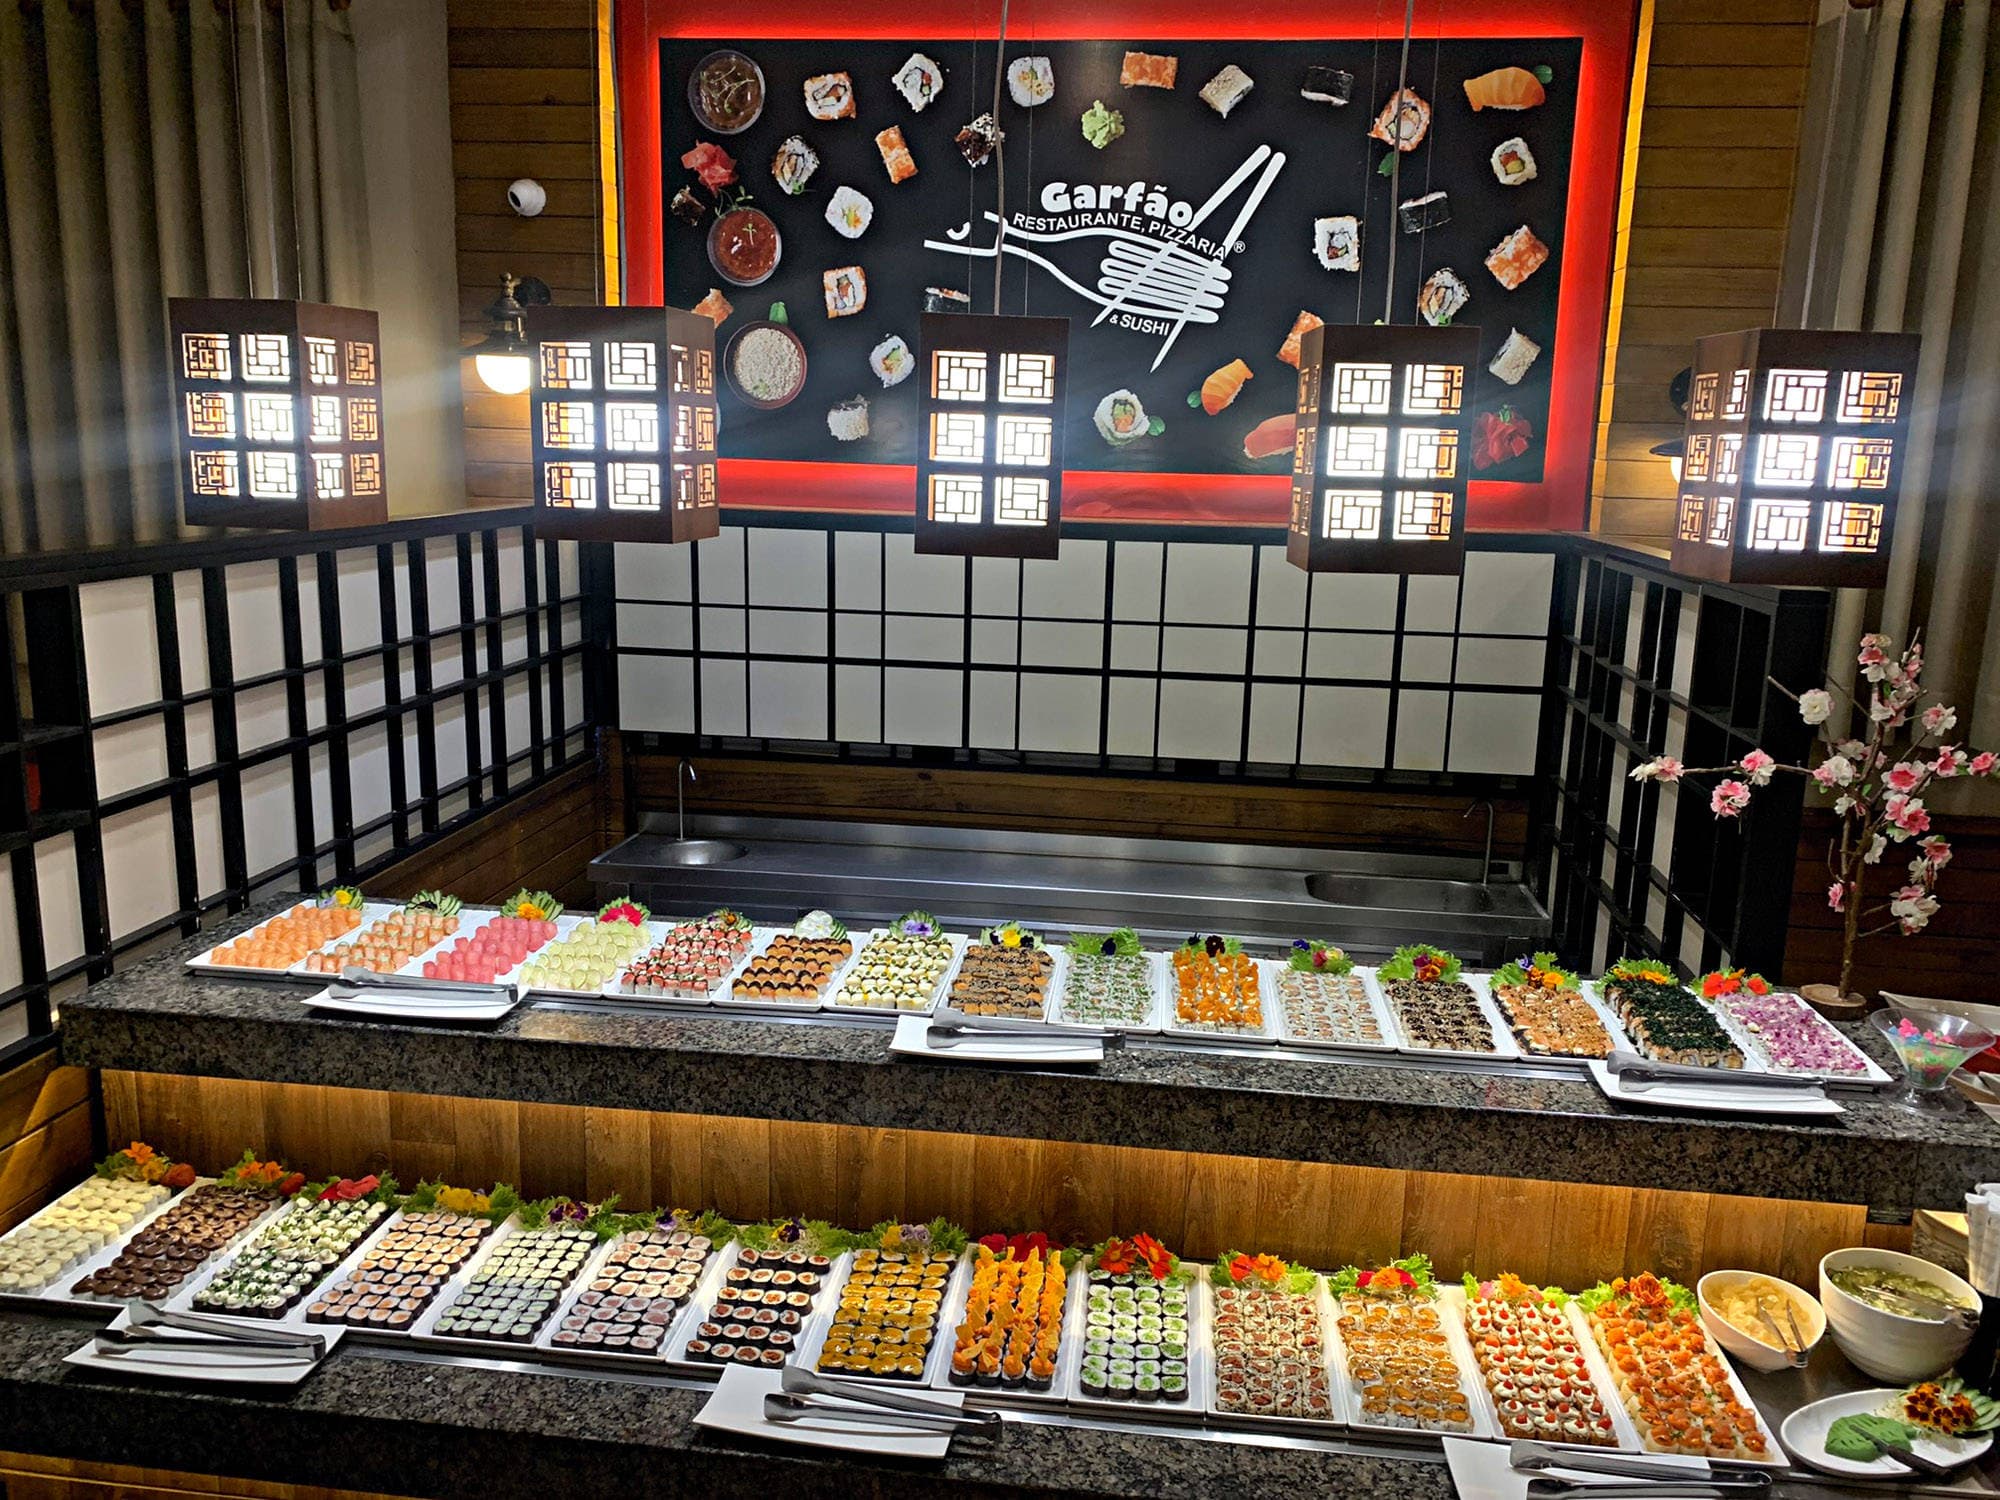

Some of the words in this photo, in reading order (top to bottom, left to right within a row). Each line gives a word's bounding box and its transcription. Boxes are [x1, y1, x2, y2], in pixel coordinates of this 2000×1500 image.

[1041, 181, 1193, 227] Garfão
[1013, 211, 1146, 233] RESTAURANTE,
[1148, 220, 1226, 261] PIZZARIA
[1109, 313, 1119, 325] &
[1119, 313, 1170, 337] SUSHI
